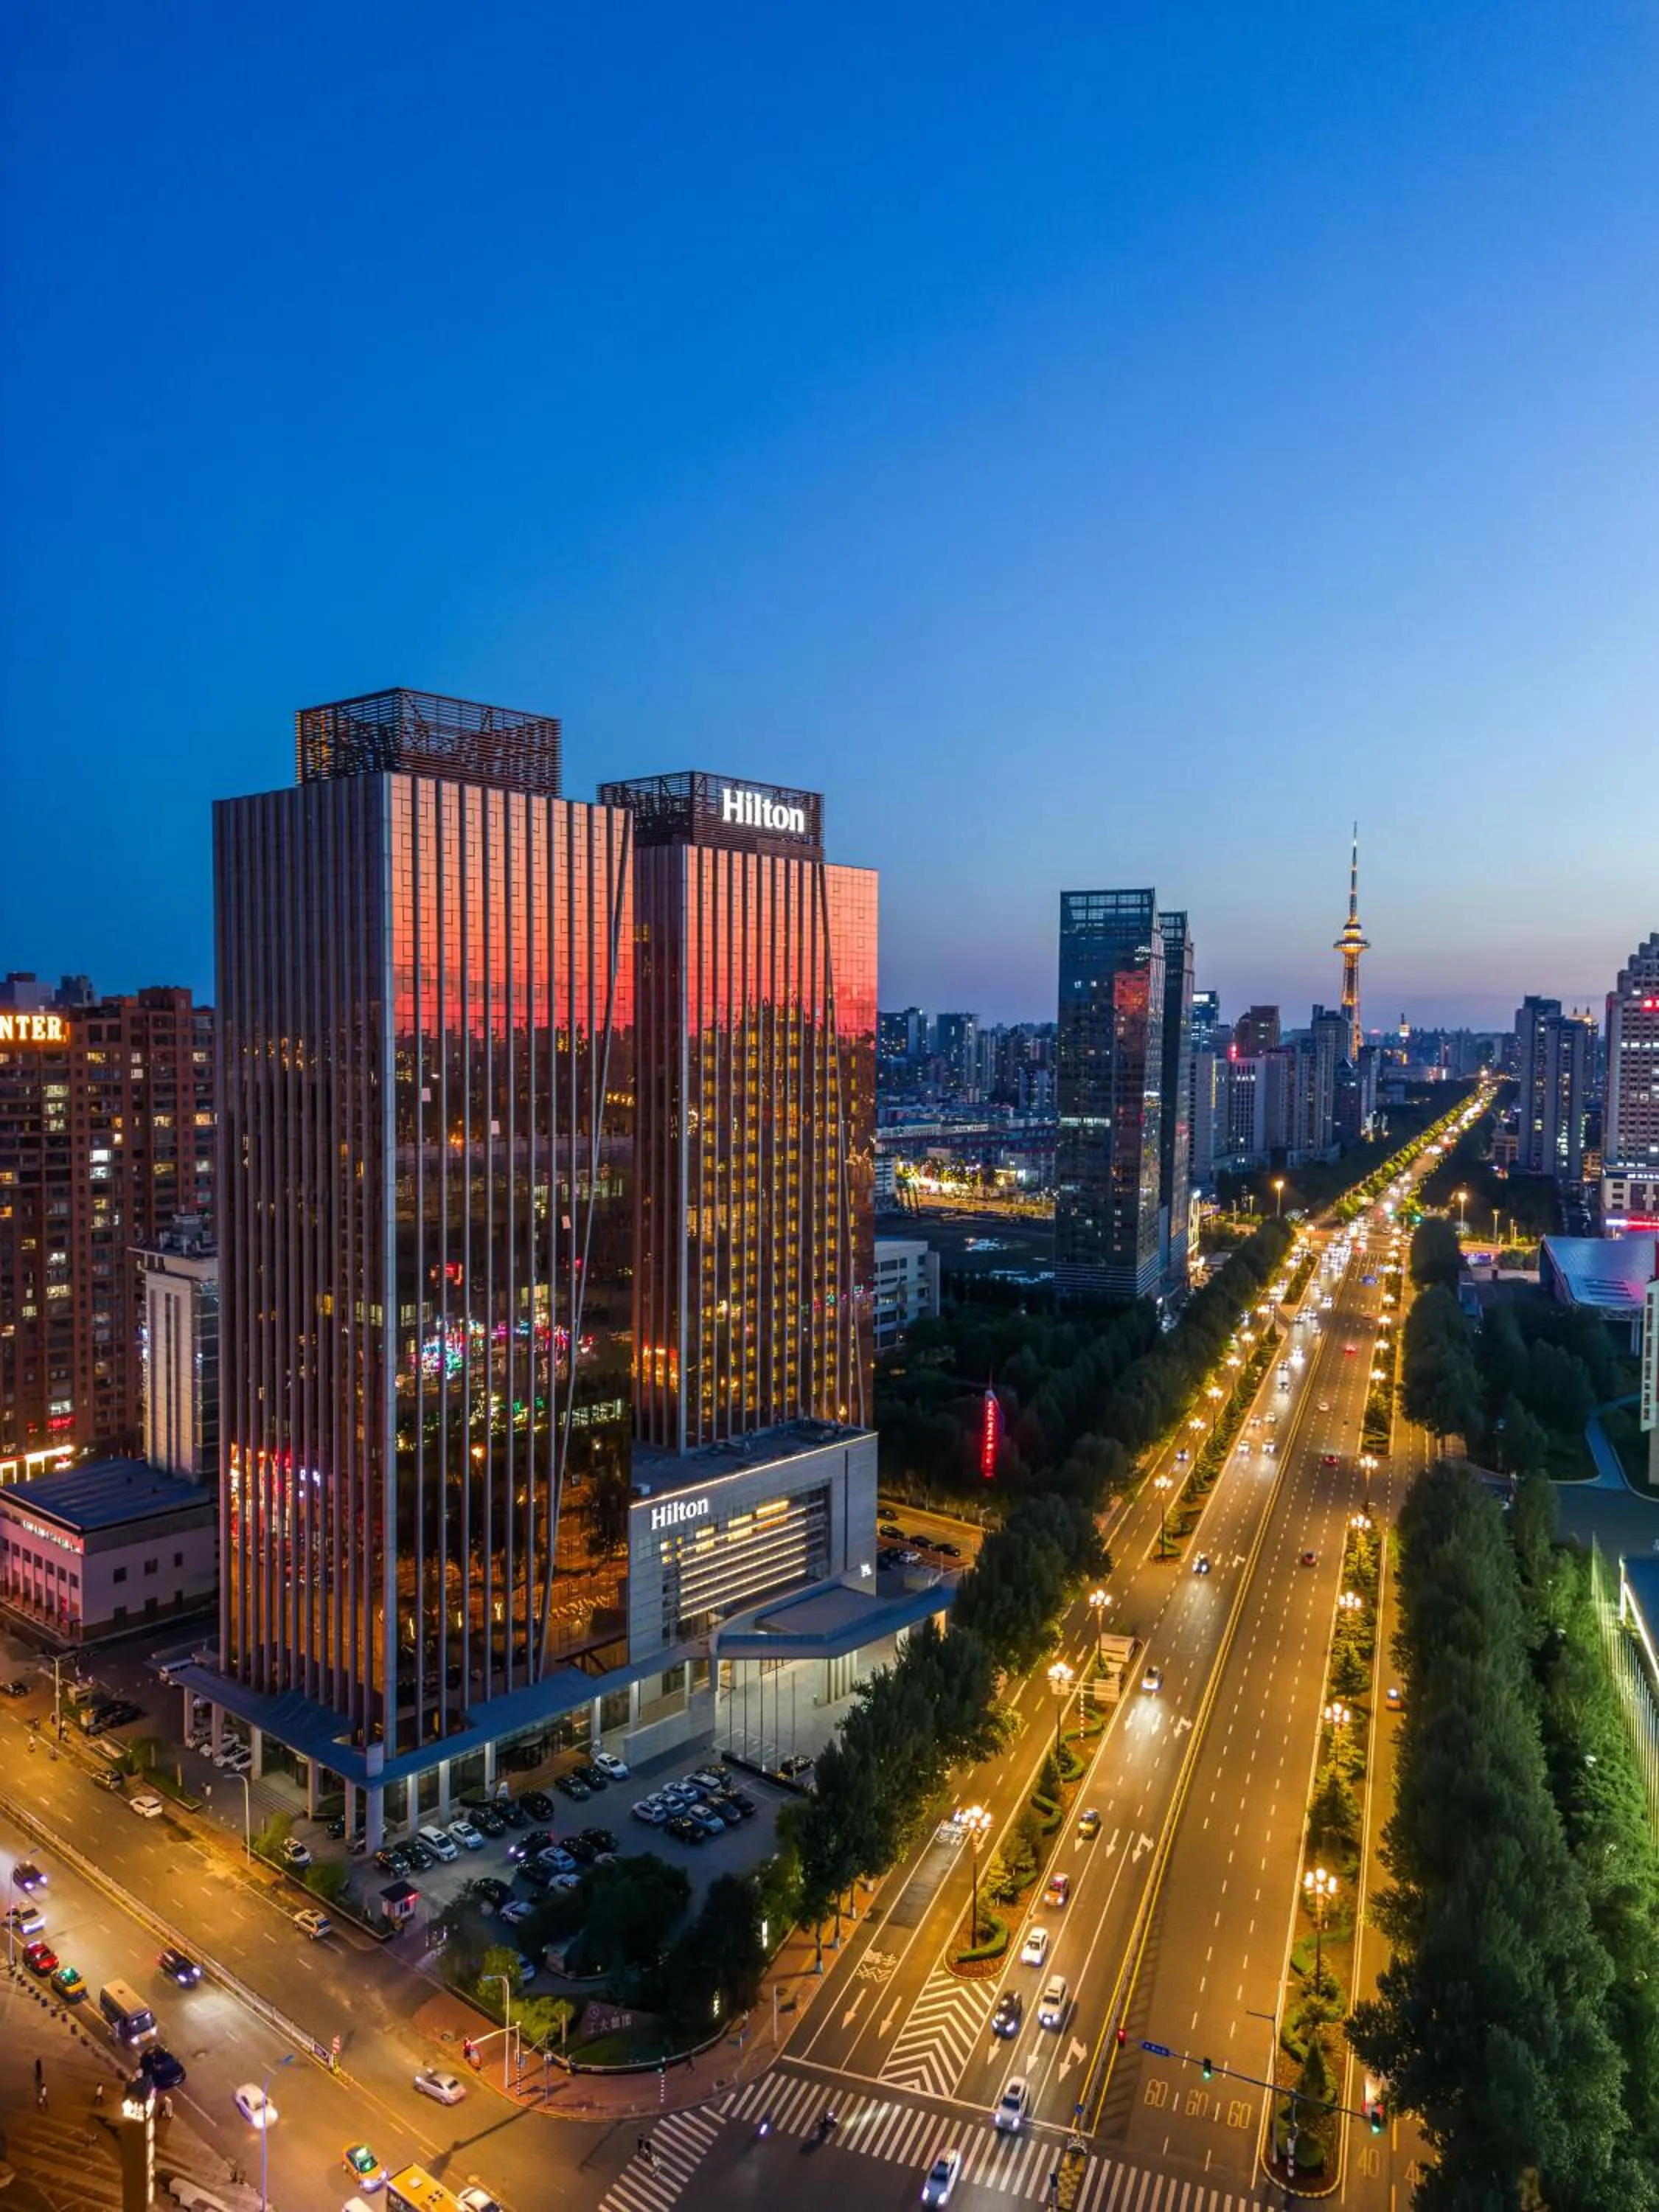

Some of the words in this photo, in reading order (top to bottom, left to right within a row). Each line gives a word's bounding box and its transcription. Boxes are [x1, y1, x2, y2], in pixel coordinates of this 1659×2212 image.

[722, 788, 804, 832] Hilton
[0, 1015, 62, 1040] NTER
[651, 1498, 709, 1530] Hilton
[1144, 2079, 1168, 2107] 60
[1227, 2100, 1251, 2129] 60
[1357, 2146, 1380, 2179] 40
